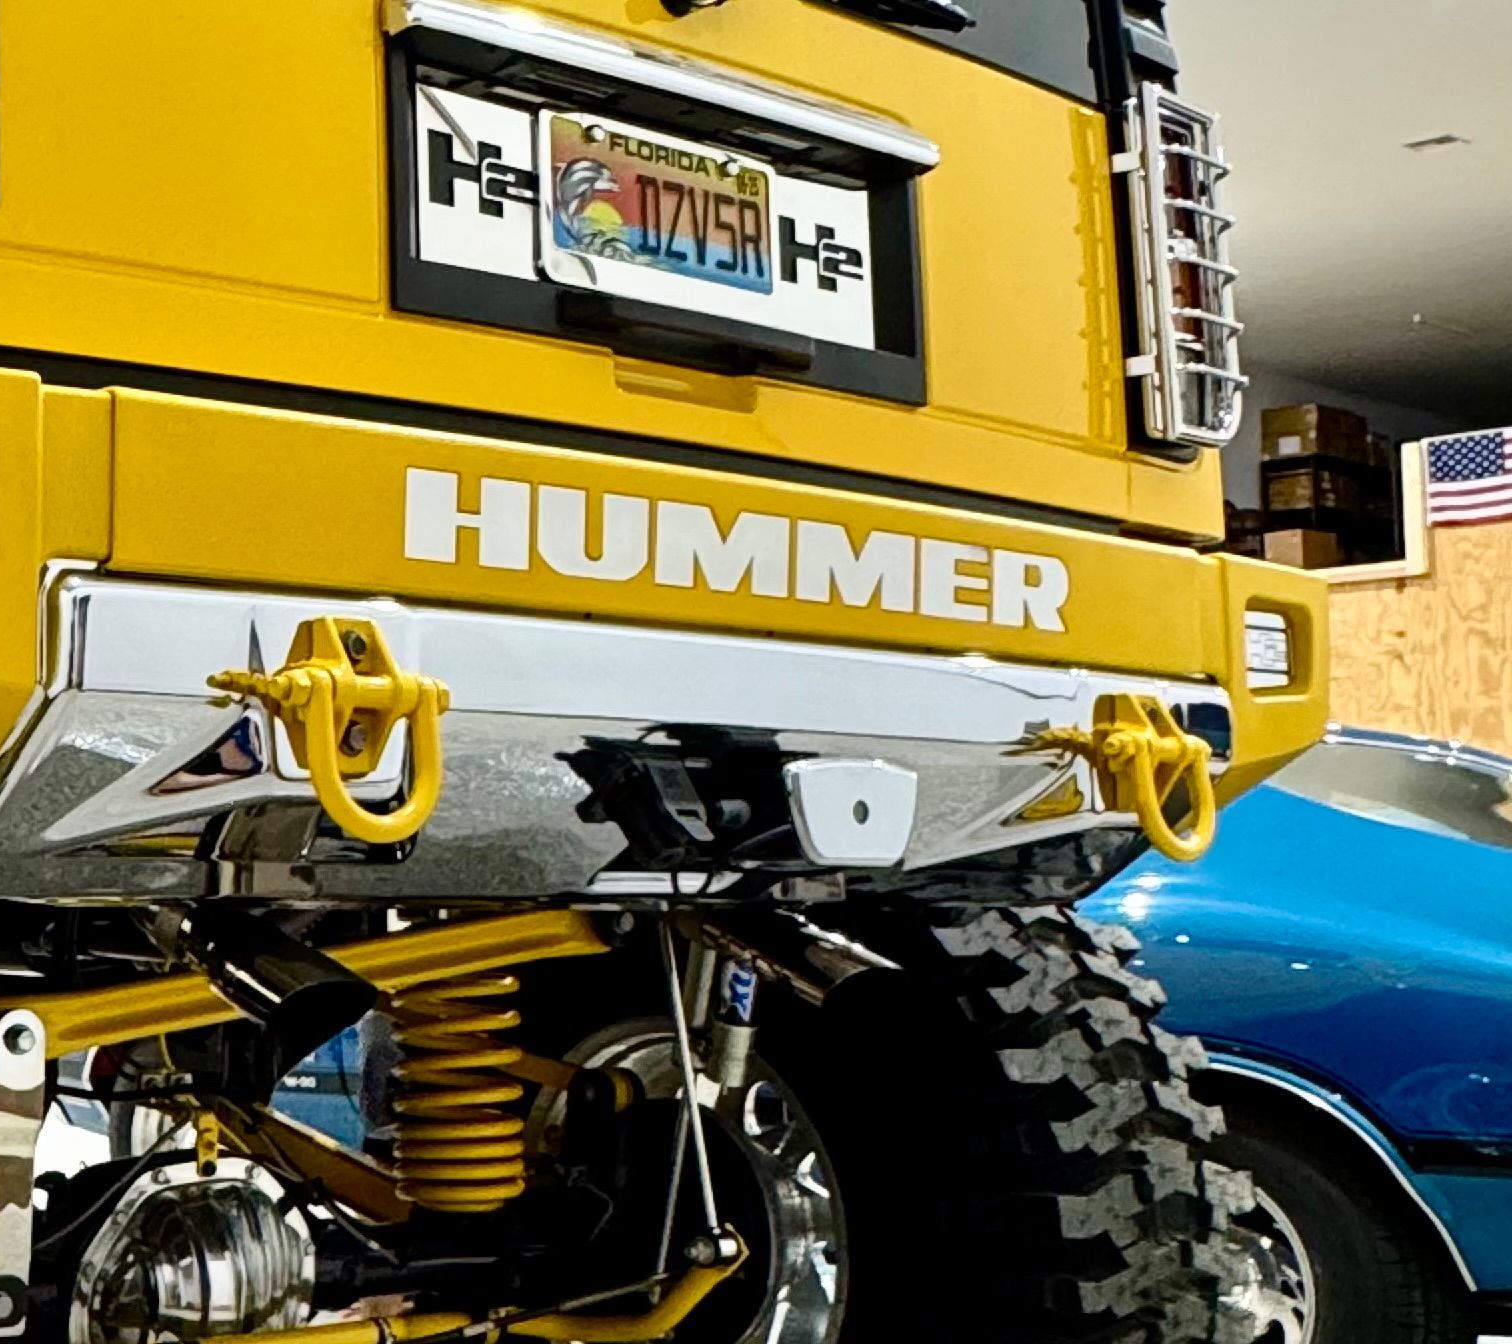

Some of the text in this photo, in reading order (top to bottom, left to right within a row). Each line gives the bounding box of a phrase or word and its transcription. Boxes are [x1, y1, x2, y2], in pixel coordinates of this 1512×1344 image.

[427, 128, 540, 218] H2
[609, 131, 709, 177] FLORIDA
[778, 214, 864, 293] H2
[404, 466, 1070, 634] HUMMER
